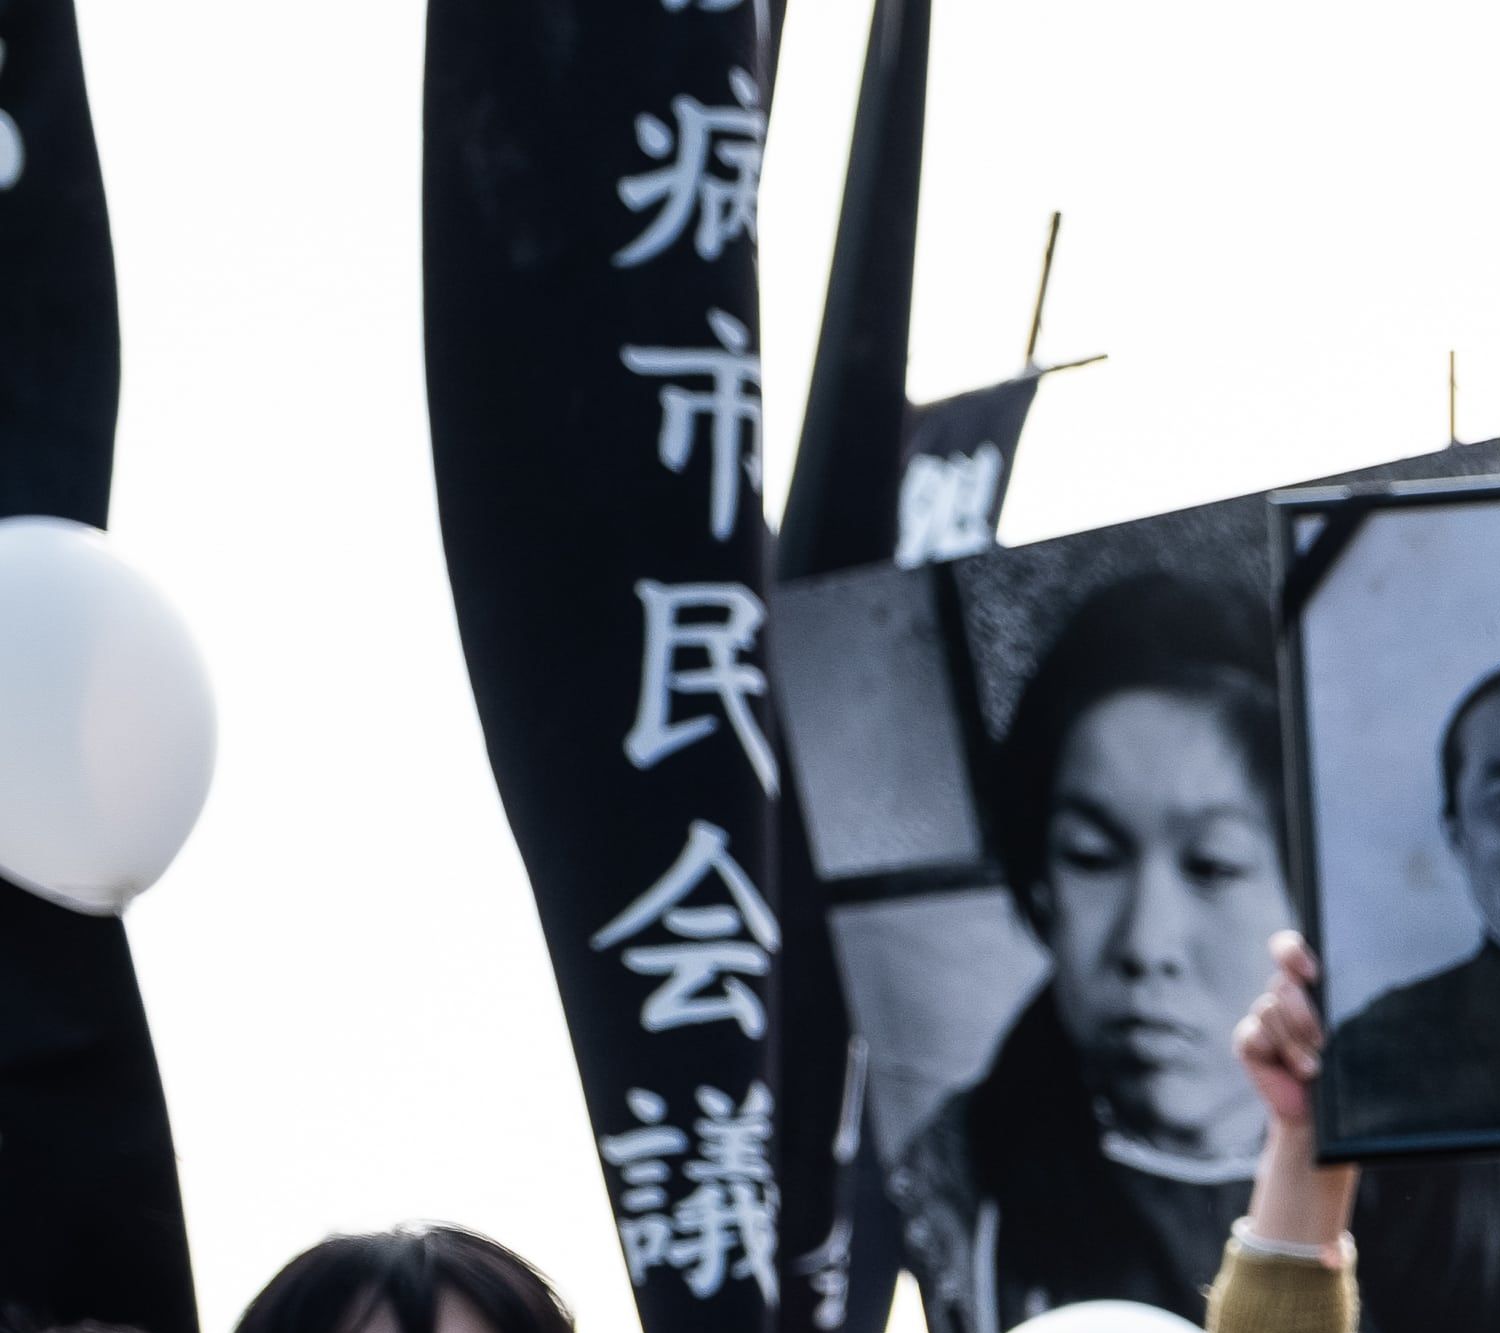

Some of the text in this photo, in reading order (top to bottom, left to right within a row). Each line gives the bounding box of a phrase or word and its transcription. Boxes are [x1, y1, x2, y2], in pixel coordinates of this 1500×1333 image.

[589, 0, 781, 1309] 病市民会議
